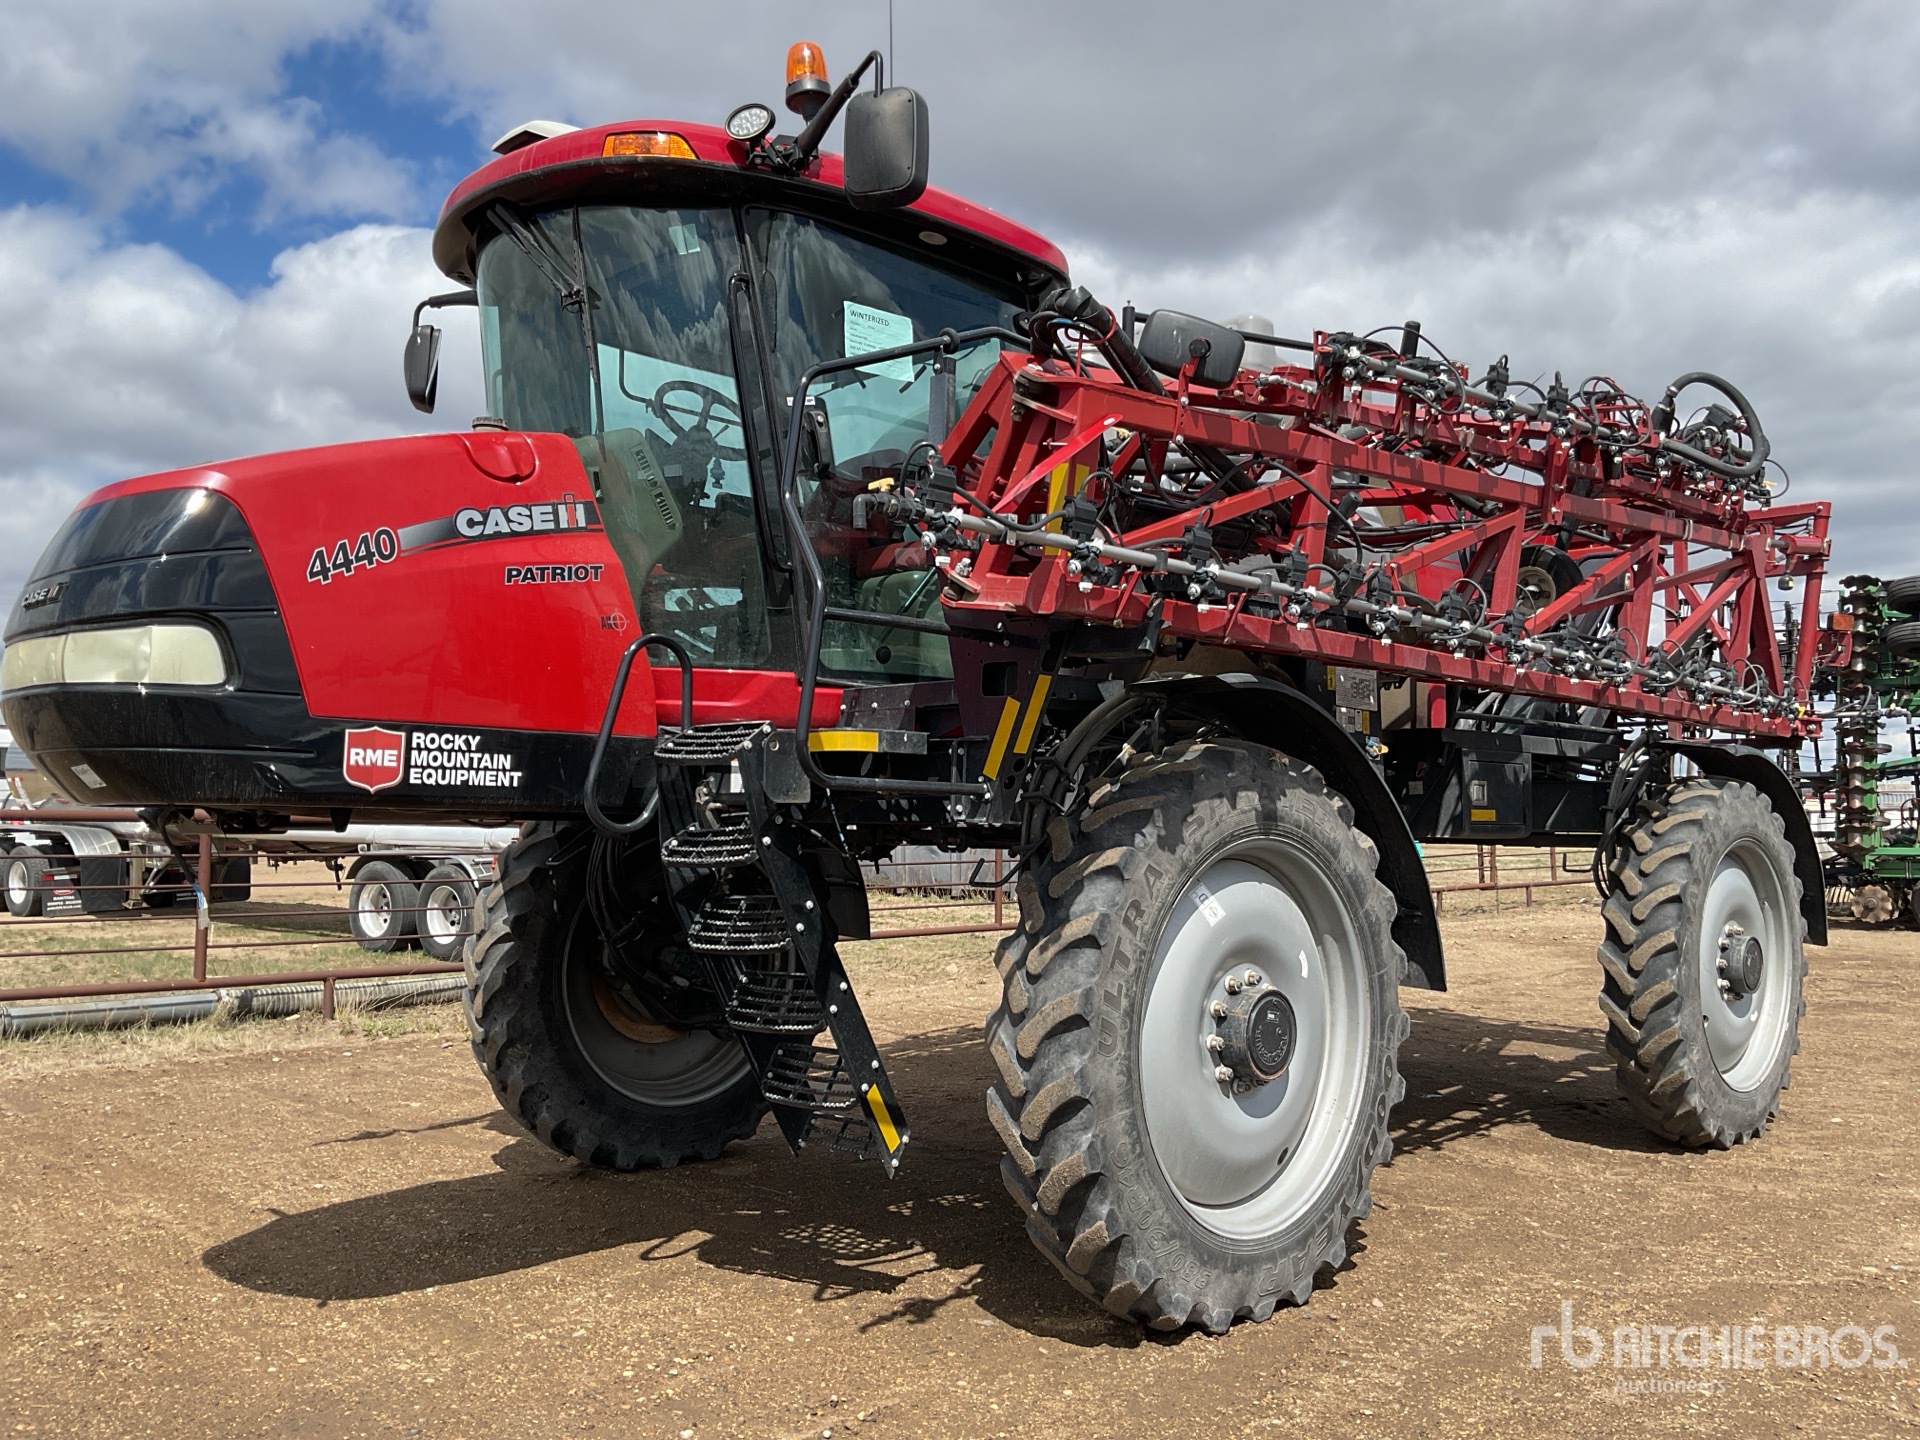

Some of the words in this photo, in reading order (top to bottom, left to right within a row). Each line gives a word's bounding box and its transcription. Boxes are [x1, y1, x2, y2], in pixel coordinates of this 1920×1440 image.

[306, 526, 398, 585] 4440
[505, 564, 604, 585] PATRIOT
[411, 731, 481, 751] ROCKY
[349, 747, 399, 767] RME
[410, 750, 511, 770] MOUNTAIN
[409, 768, 522, 788] EQUIPMENT
[1097, 863, 1163, 1058] ULTRA
